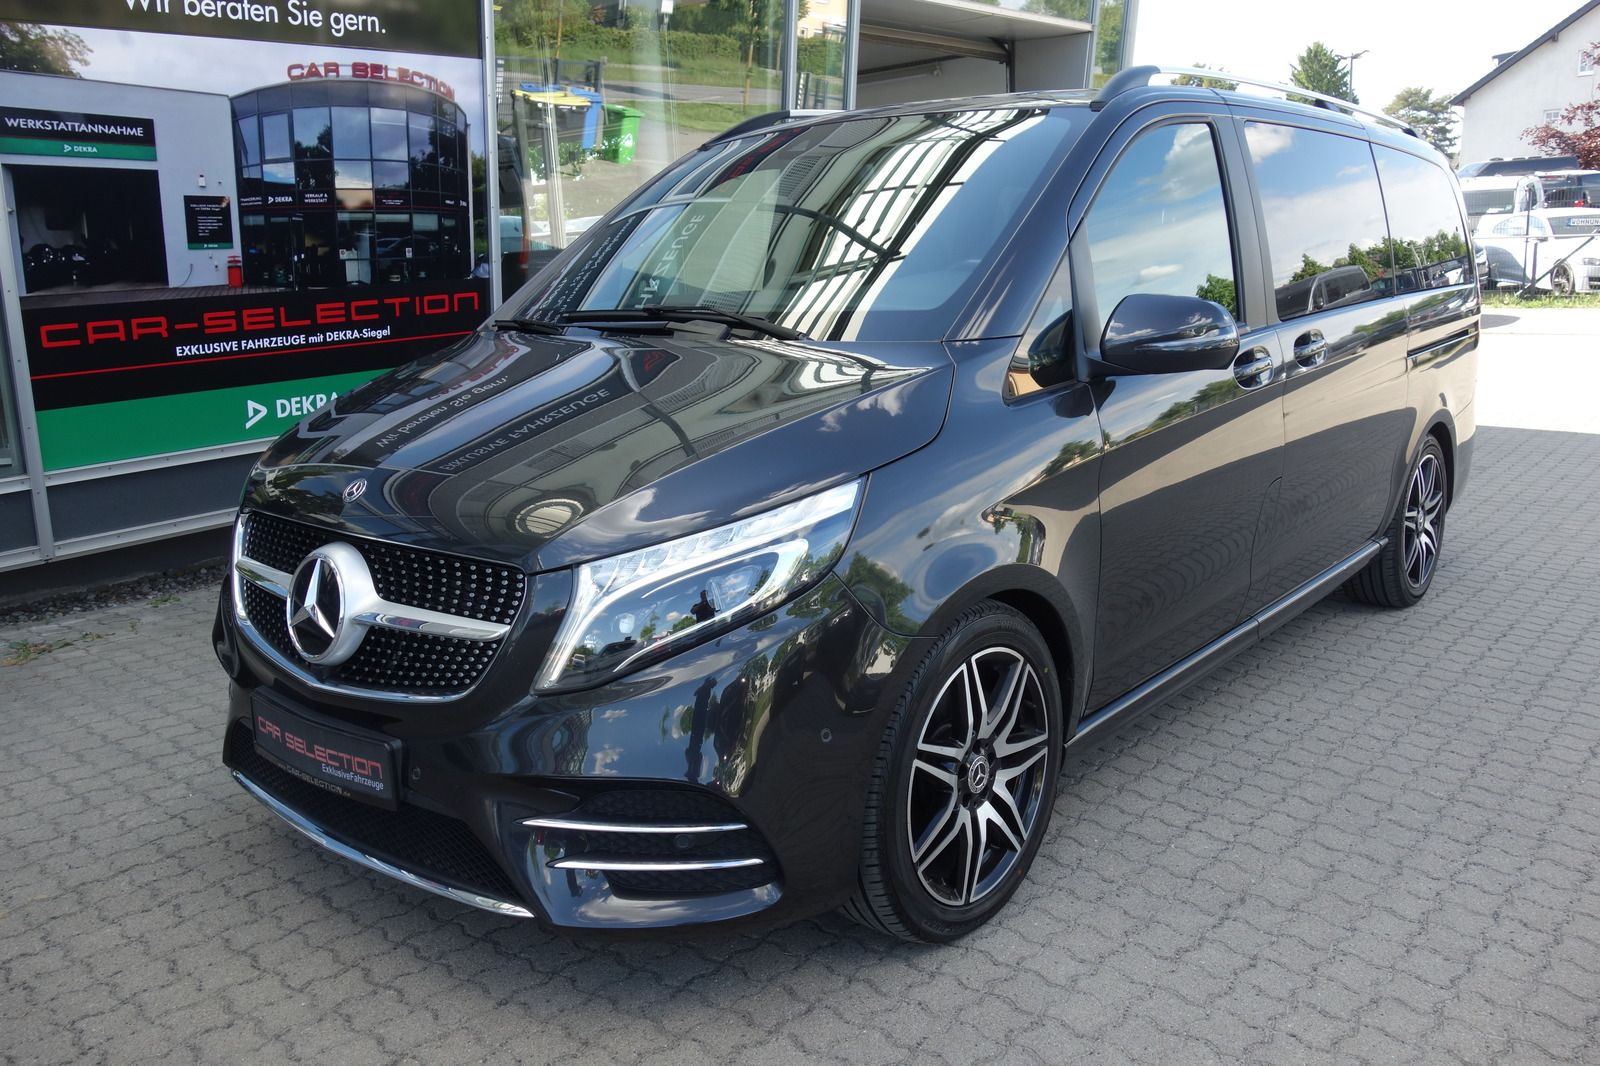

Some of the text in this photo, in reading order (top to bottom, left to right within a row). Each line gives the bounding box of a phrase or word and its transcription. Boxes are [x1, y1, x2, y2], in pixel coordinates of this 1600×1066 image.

[184, 0, 279, 24] beraten
[287, 1, 324, 27] Sie
[330, 11, 387, 37] gern.
[287, 61, 456, 99] CAR SELECTION
[4, 117, 144, 137] WERKSTATTANNAHME
[73, 145, 98, 153] DEKRA
[39, 292, 480, 348] CAR-SELECTION
[175, 325, 391, 357] EXKLUSIVE FAHRZEUGE mit DEKRA-Siegel
[257, 716, 383, 780] CAR SELECTION
[321, 763, 384, 790] ExklusiveFahrzeuge
